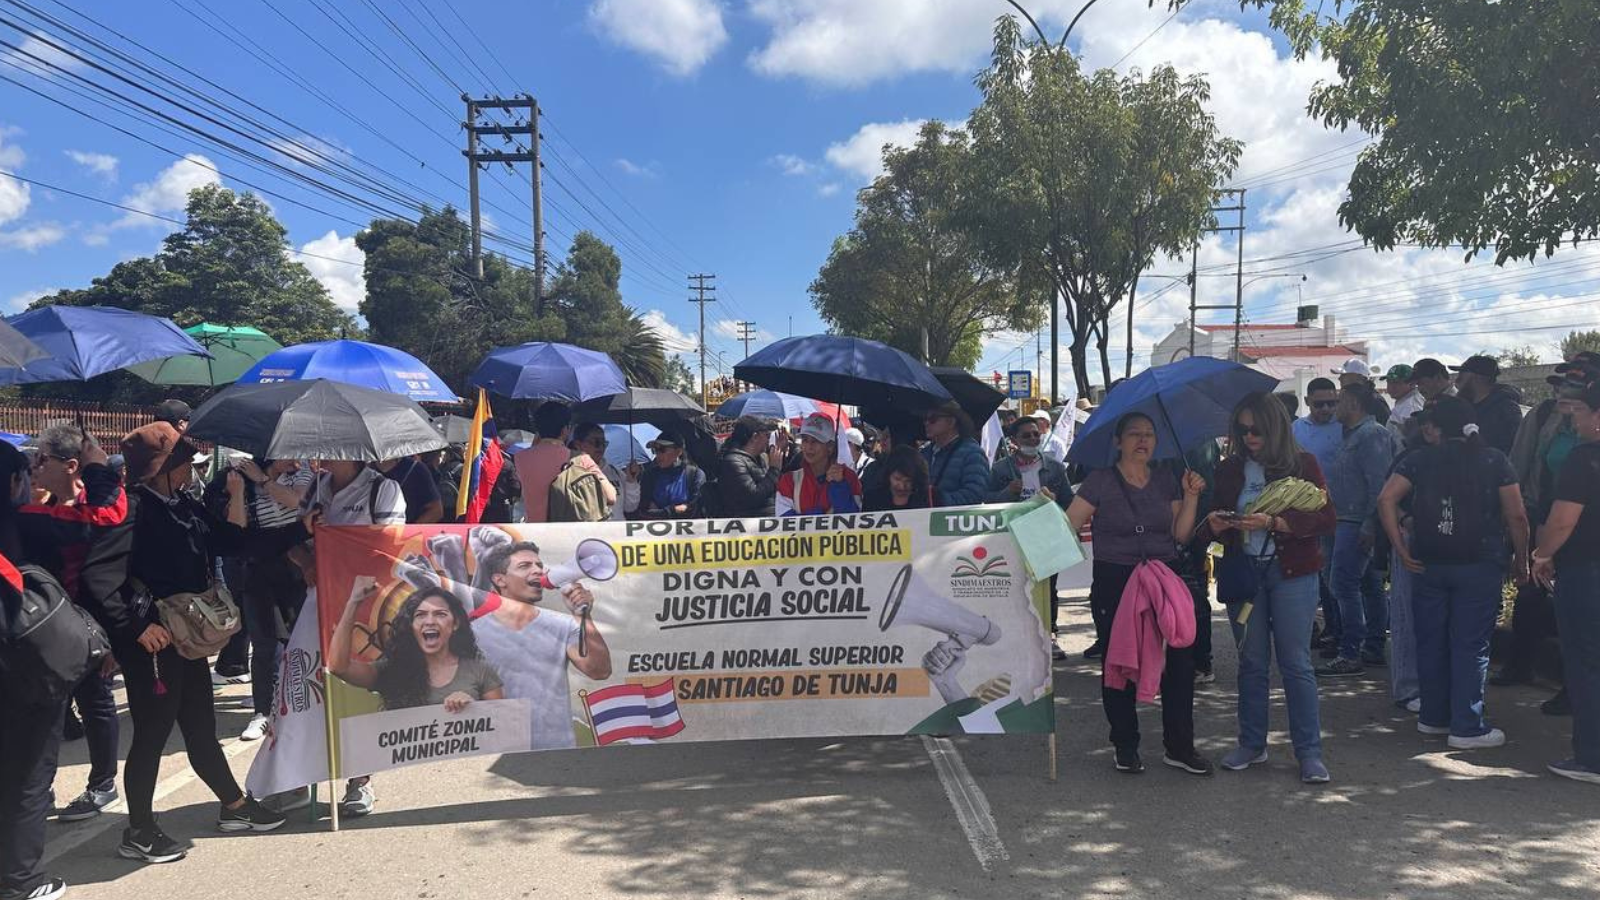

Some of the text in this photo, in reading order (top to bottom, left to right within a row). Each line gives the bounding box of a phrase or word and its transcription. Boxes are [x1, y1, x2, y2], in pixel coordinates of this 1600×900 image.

[626, 513, 898, 537] POR LA DEFENSA
[945, 515, 1008, 531] TUNJ
[621, 531, 902, 567] DE UNA EDUCACIÓN PÚBLICA
[663, 566, 862, 591] DIGNA Y CON
[950, 579, 1012, 587] SINDIMAESTROS
[655, 587, 871, 622] JUSTICIA SOCIAL
[628, 645, 904, 673] ESCUELA NORMAL SUPERIOR
[677, 672, 898, 700] SANTIAGO DE TUNJA
[378, 717, 495, 748] COMITÉ ZONAL
[392, 736, 480, 764] MUNICIPAL
